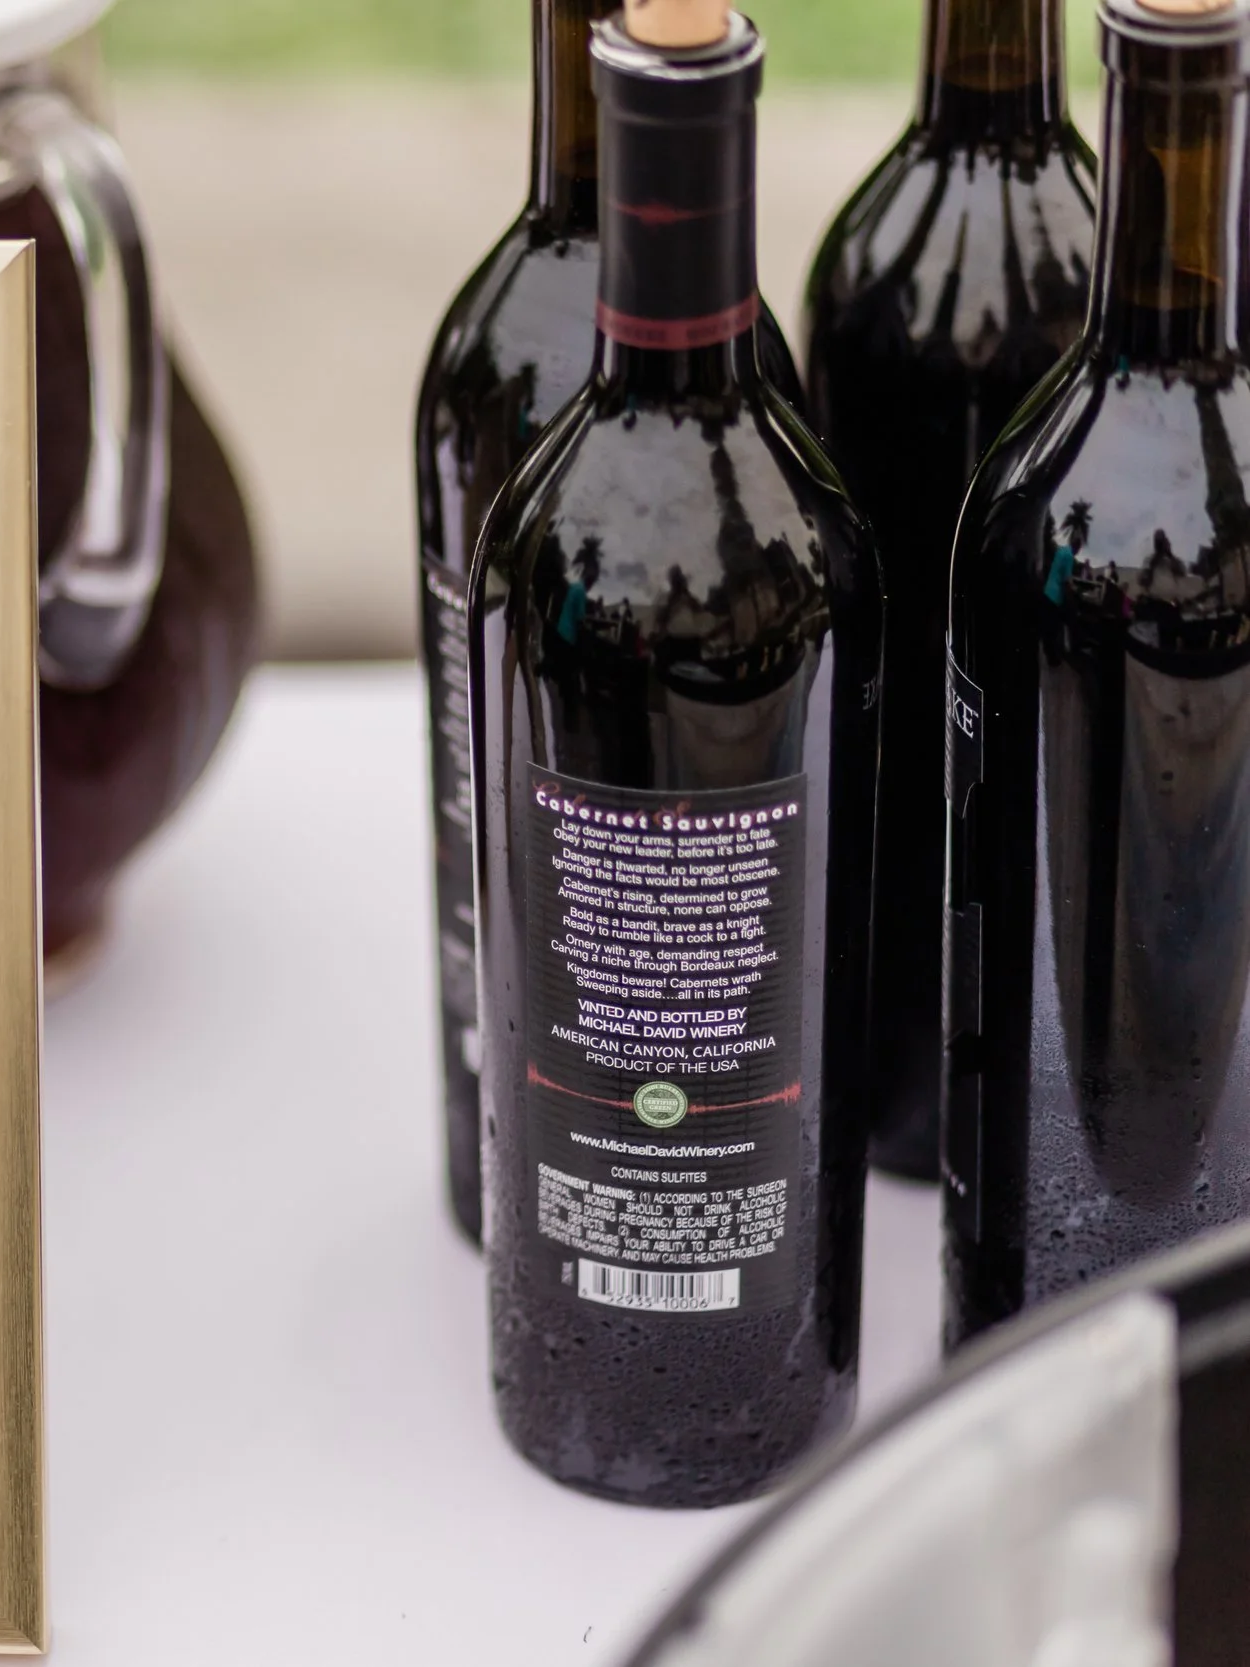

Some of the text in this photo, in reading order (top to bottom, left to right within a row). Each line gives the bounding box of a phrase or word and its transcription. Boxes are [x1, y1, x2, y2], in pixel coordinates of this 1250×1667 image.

[536, 791, 648, 829] Cabernet
[553, 828, 580, 847] Obey
[582, 838, 606, 850] your
[609, 843, 633, 855] new
[677, 846, 715, 858] before
[717, 845, 733, 856] it's
[736, 844, 754, 854] too
[756, 838, 779, 850] late.
[561, 818, 580, 835] Lay
[582, 824, 611, 840] down
[615, 832, 640, 844] your
[677, 833, 733, 847] surrender
[736, 832, 747, 843] to
[749, 828, 770, 840] fate
[552, 855, 780, 887] Ignoring the facts would be most obscene.
[562, 848, 601, 867] Danger
[603, 857, 612, 869] is
[671, 866, 686, 875] no
[689, 864, 725, 876] longer
[728, 857, 768, 872] unseen
[558, 886, 772, 915] Armored in structure, none can oppose.
[563, 876, 619, 899] Cabernet's
[659, 891, 724, 903] determined
[727, 890, 738, 900] to
[740, 886, 767, 901] grow
[562, 915, 767, 943] Ready to rumble like a cock to a fight.
[570, 906, 760, 932] Bold as a bandit, brave as a knight
[551, 939, 779, 973] Carving a niche through Bordeaux neglect.
[565, 933, 764, 961] Ornery with age, demanding respect
[566, 961, 762, 988] Kingdoms beware! Cabernets wrath
[576, 976, 628, 998] Sweeping
[694, 989, 705, 999] in
[707, 988, 721, 999] its
[723, 985, 751, 999] path.
[577, 998, 748, 1023] VINTED AND BOTTLED BY
[578, 1014, 747, 1039] MICHAEL DAVID WINERY
[551, 1024, 776, 1059] AMERICAN CANYON, CALIFORNIA
[586, 1051, 740, 1073] PRODUCT OF THE USA
[570, 1131, 755, 1158] www.MichaelDavidWinery.com
[538, 1162, 590, 1191] GOVERNMENT
[592, 1182, 636, 1201] WARNING:
[653, 1192, 708, 1204] ACCORDING
[710, 1191, 723, 1203] TO
[726, 1188, 744, 1200] THE
[746, 1178, 787, 1198] SURGEON
[611, 1166, 707, 1183] CONTAINS SULFITES
[583, 1193, 616, 1209] WOMEN
[626, 1202, 663, 1215] SHOULD
[673, 1205, 693, 1216] NOT
[703, 1203, 731, 1215] DRINK
[739, 1190, 786, 1211] ALCOHOLIC
[583, 1201, 787, 1228] DURING PREGNANCY BECAUSE OF THE RISK OF
[640, 1214, 785, 1240] CONSUMPTION OF ALCOHOLIC
[624, 1231, 768, 1252] YOUR ABILITY TO DRIVE CAR
[622, 1249, 728, 1264] AND MAY CAUSE HEALTH
